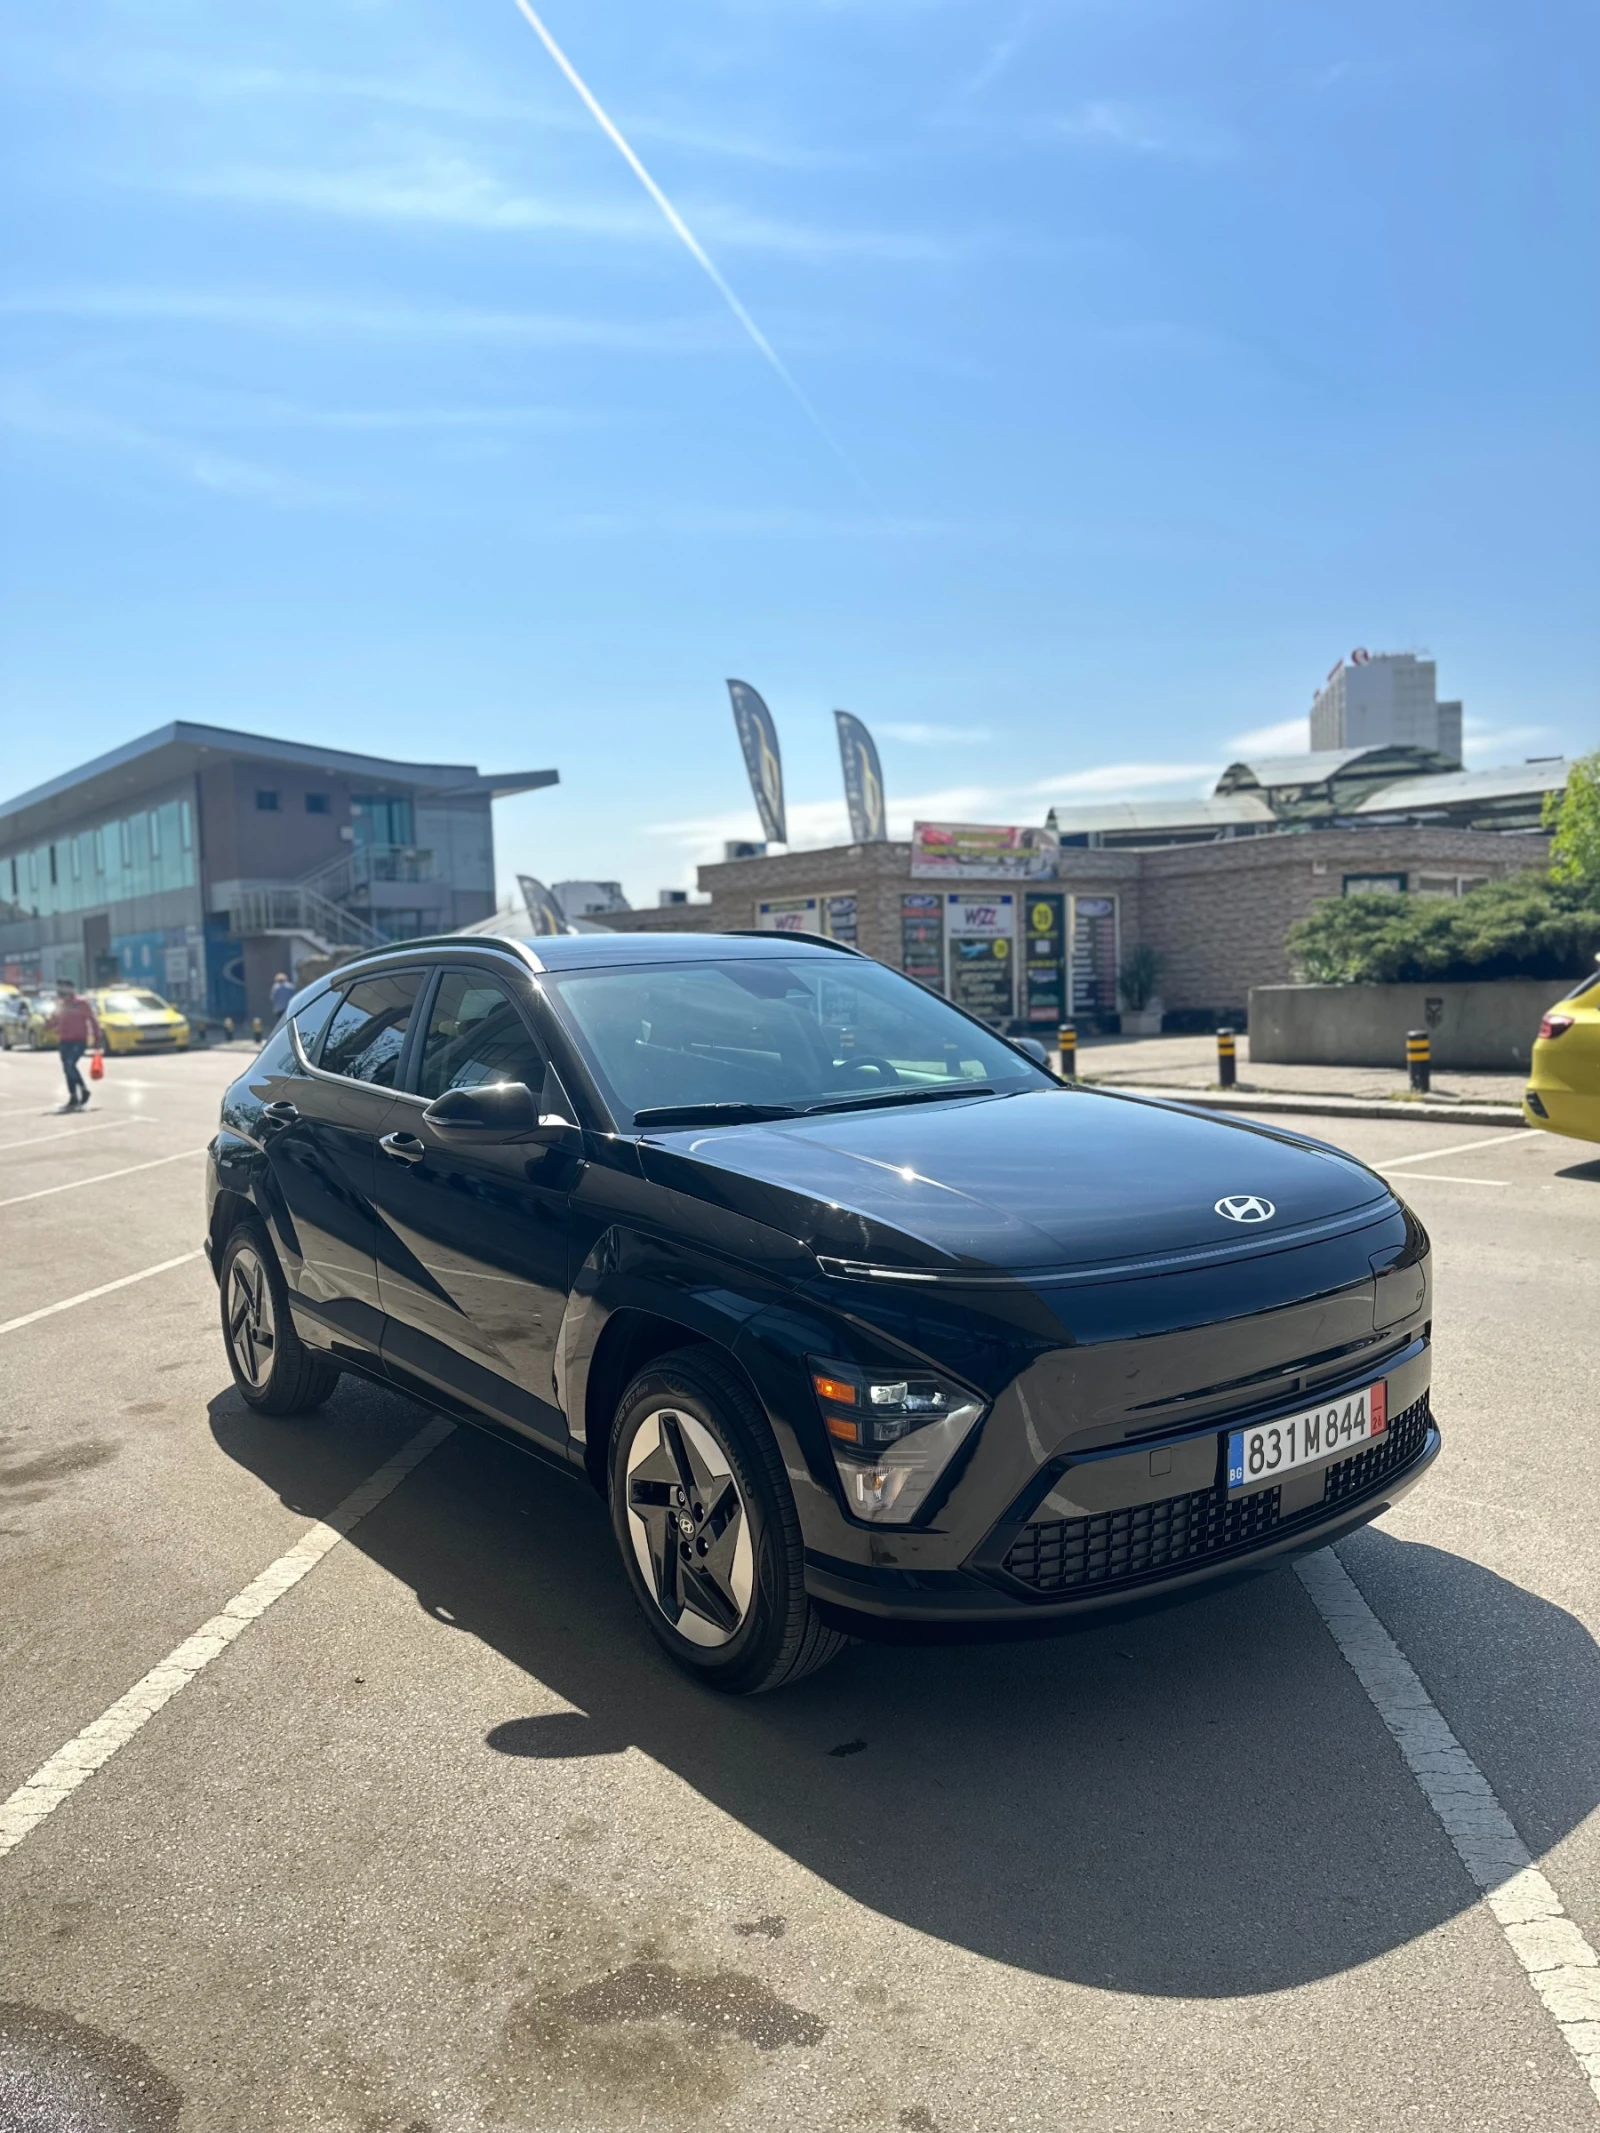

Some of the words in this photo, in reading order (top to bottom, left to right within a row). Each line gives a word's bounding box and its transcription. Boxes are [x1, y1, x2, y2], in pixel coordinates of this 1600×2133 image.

[1372, 1416, 1383, 1430] 26
[1248, 1422, 1296, 1475] 831
[1304, 1414, 1321, 1458] M
[1325, 1396, 1366, 1448] 844
[1229, 1467, 1243, 1482] BG
